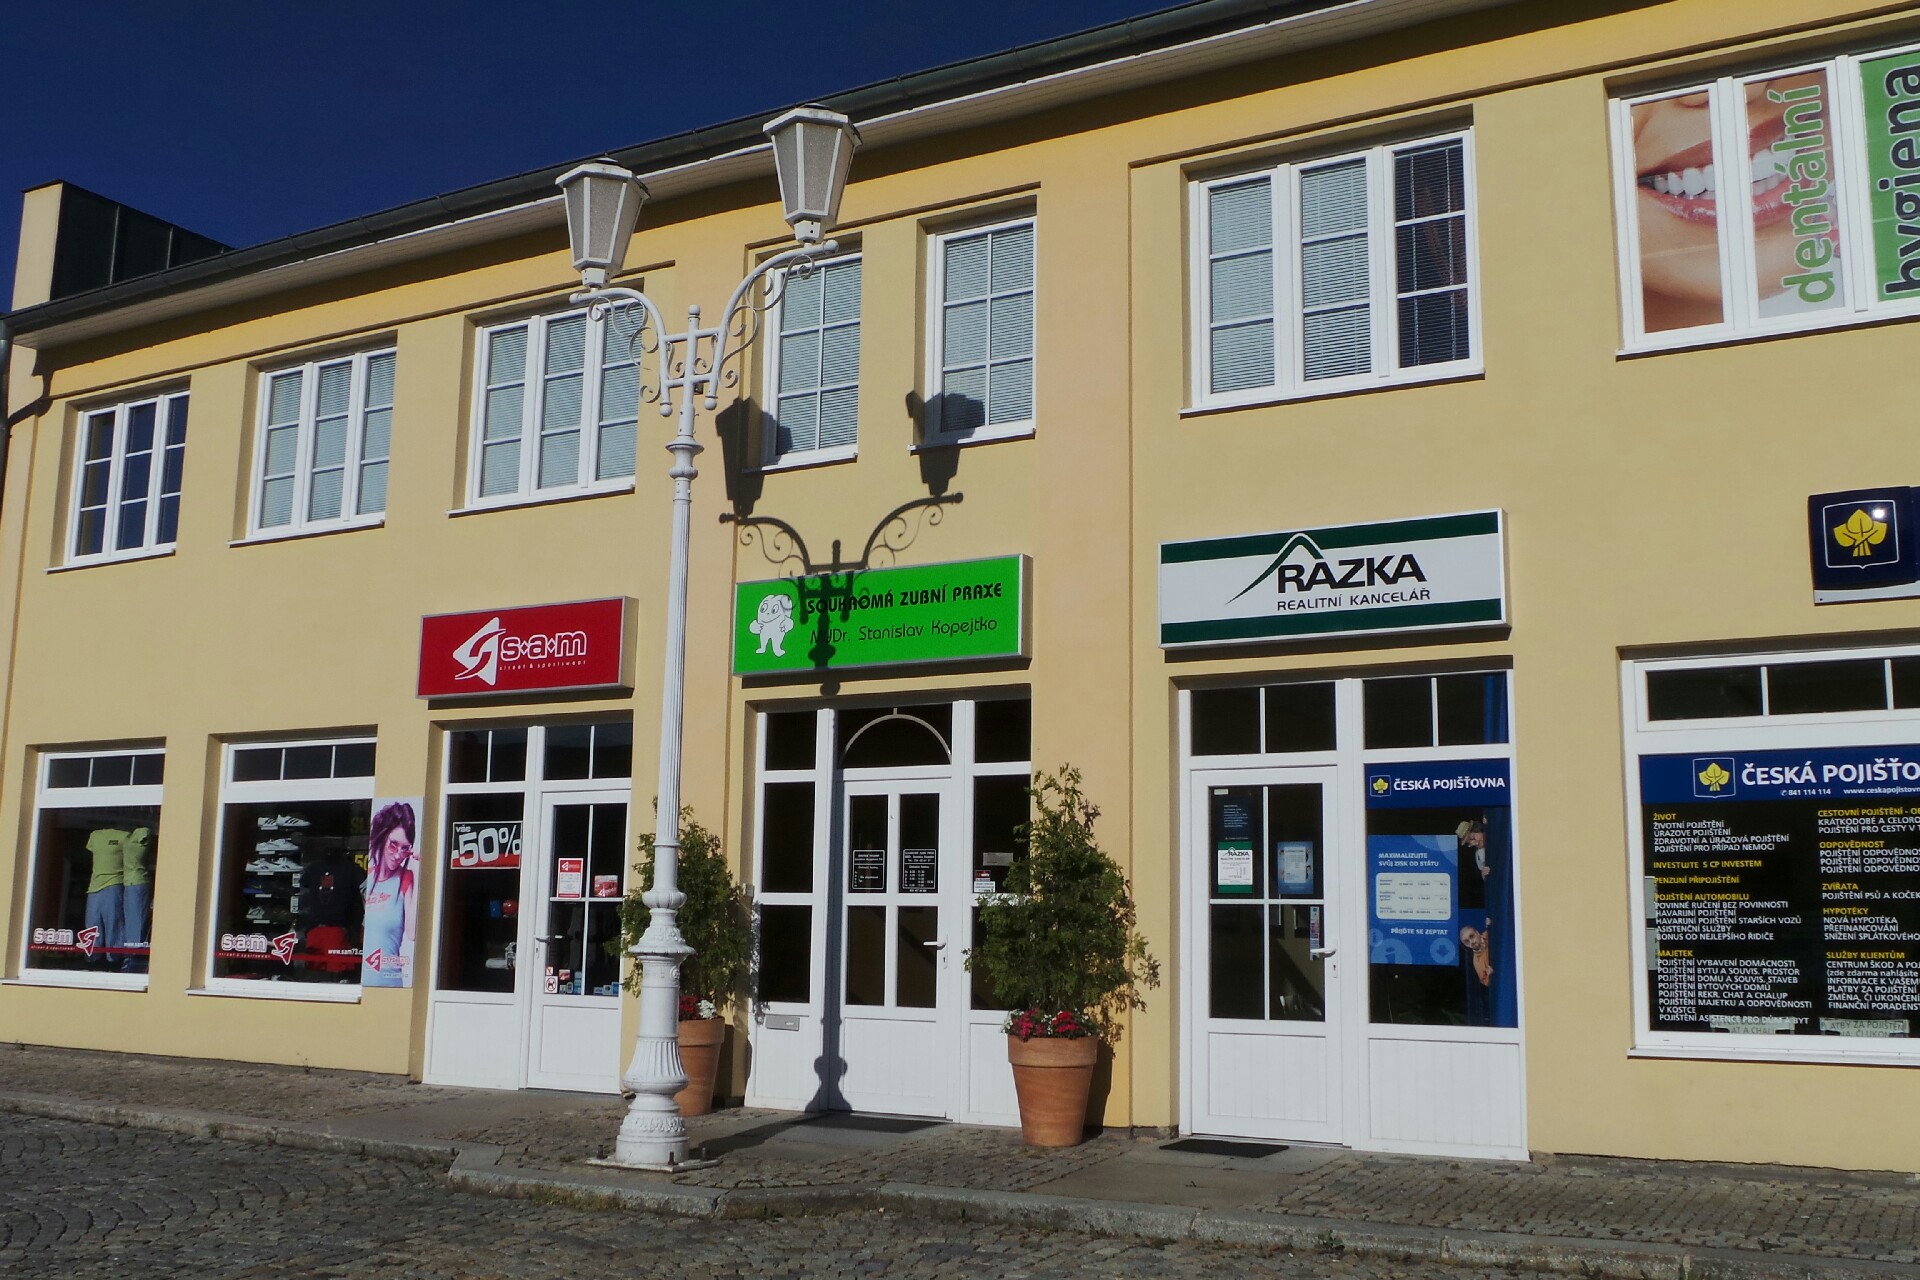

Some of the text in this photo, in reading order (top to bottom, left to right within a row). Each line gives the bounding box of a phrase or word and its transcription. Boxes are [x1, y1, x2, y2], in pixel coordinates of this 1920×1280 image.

[1768, 85, 1836, 303] dentální
[1277, 553, 1427, 594] RAZKA
[899, 583, 948, 607] ZUBNÍ
[952, 582, 1003, 602] PRAXE
[1277, 587, 1431, 612] REALITNÍ KANCELÁŘ
[858, 623, 924, 641] Stanislav
[931, 617, 998, 639] Kopejtko
[1741, 757, 1920, 786] ČESKÁ POJIŠŤO
[1393, 776, 1506, 791] ČESKÁ POJIŠŤOVNA
[1818, 806, 1903, 817] CESTOVNÍ POJIŠTĚNÍ
[1653, 820, 1725, 829] ŽIVOTNÍ POJIŠTĚNÍ
[1818, 816, 1876, 826] KRÁTKODOBÉ
[455, 825, 471, 833] vše
[1693, 828, 1731, 836] POJIŠTĚNÍ
[1819, 825, 1859, 834] POJIŠTĚNÍ
[1861, 825, 1879, 833] PRO
[1881, 825, 1906, 833] CESTY
[1654, 836, 1700, 845] ZDRAVOTNÍ
[1710, 835, 1748, 843] ÚRAZOVÁ
[1750, 834, 1790, 842] POJIŠTĚNÍ
[1819, 840, 1885, 848] ODPOVĚDNOST
[1654, 844, 1692, 853] POJIŠTĚNÍ
[1711, 843, 1740, 851] PŘÍPAD
[1742, 843, 1775, 851] NEMOCI
[1820, 848, 1920, 857] POJIŠTĚNÍ ODPOVĚDNO
[1820, 856, 1920, 865] POJIŠTĚNÍ ODPOVĚDNO
[1821, 865, 1862, 873] POJIŠTĚNÍ
[1689, 875, 1740, 884] PŘIPOJIŠTĚNÍ
[1822, 882, 1859, 890] ZVÍŘATA
[1655, 893, 1693, 901] POJIŠTĚNÍ
[1822, 891, 1863, 900] POJIŠTĚNÍ
[1865, 890, 1881, 899] PSŮ
[1655, 900, 1789, 909] POVINNÉ RUČENÍ BEZ POVINNOSTI
[1655, 908, 1736, 917] HAVARIJNÍ POJIŠTĚNÍ
[1823, 907, 1869, 915] HYPOTÉKY
[1656, 915, 1802, 925] HAVARIJNÍ POJIŠTĚNÍ STARŠÍCH VOZŮ
[1823, 915, 1898, 924] NOVÁ HYPOTÉKA
[1657, 924, 1731, 932] ASISTENČNÍ SLUŽBY
[1824, 923, 1899, 932] PŘEFINANCOVÁNÍ
[1656, 933, 1683, 941] BONUS
[1700, 932, 1746, 941] NEJLEPŠÍHO
[1748, 932, 1774, 940] ŘIDIČE
[1824, 932, 1857, 940] SNÍŽENÍ
[1826, 950, 1905, 959] SLUŽBY KLIENTŮM
[1658, 958, 1795, 967] POJIŠTĚNÍ VYBAVENÍ DOMÁCNOSTI
[1826, 961, 1868, 969] CENTRUM
[1870, 960, 1894, 968] ŠKOD
[1658, 967, 1695, 975] POJIŠTĚNÍ
[1762, 968, 1800, 976] PROSTOR
[1846, 969, 1878, 977] zdarma
[1658, 974, 1695, 982] POJIŠTĚNÍ
[1734, 975, 1765, 983] SOUVIS.
[1767, 976, 1798, 984] STAVEB
[1658, 982, 1771, 991] POJIŠTĚNÍ BYTOVÝCH DOMŮ
[1875, 984, 1917, 993] POJIŠTĚNÍ
[1658, 990, 1696, 998] POJIŠTĚNÍ
[1722, 991, 1744, 999] CHAT
[1754, 992, 1788, 1000] CHALUP
[1864, 993, 1872, 1001] ČI
[1874, 992, 1920, 1002] UKONČENÍ
[1658, 998, 1812, 1009] POJIŠTĚNÍ MAJETKU A ODPOVĚDNOSTI
[1828, 1001, 1870, 1010] FINANČNÍ
[1659, 1013, 1697, 1022] POJIŠTĚNÍ
